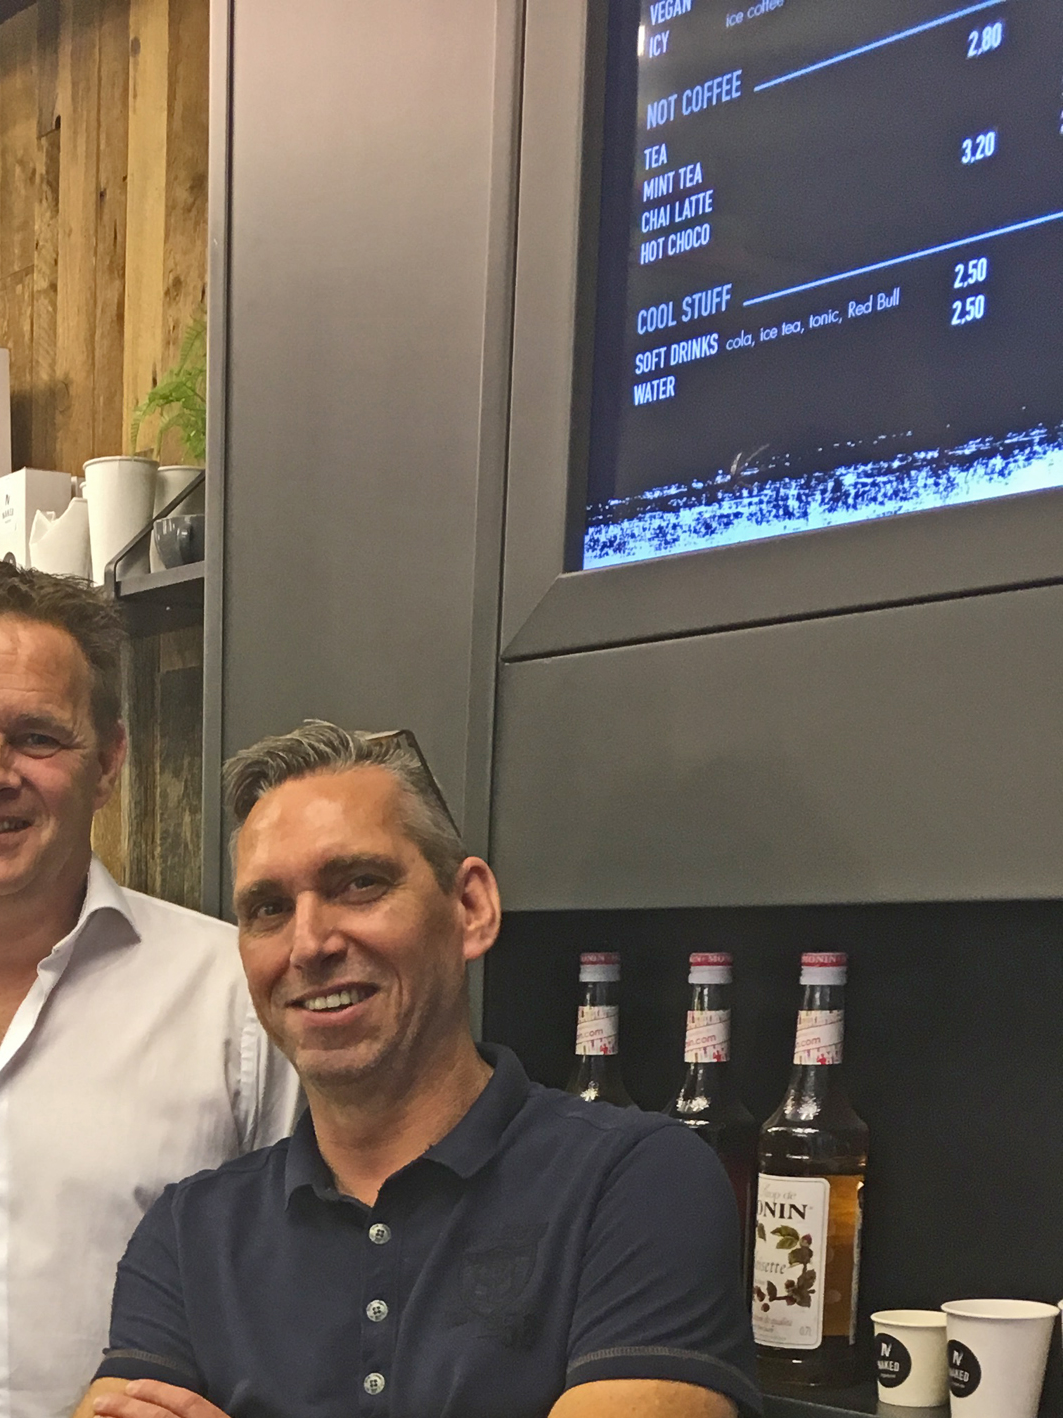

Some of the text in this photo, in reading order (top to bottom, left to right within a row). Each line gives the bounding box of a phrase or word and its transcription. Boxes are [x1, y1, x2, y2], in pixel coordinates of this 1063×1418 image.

[650, 0, 692, 26] VEGAN
[726, 12, 744, 28] ice
[649, 30, 670, 58] ICY
[966, 22, 1003, 59] 2,80
[646, 69, 743, 130] NOT COFFEE
[644, 143, 668, 171] TEA
[961, 131, 996, 164] 3,20
[643, 162, 703, 203] MINT TEA
[641, 189, 714, 233] CHAI LATTE
[640, 223, 710, 265] HOT CHOCO
[953, 257, 988, 289] 2,50
[637, 283, 733, 335] COOL STUFF
[950, 294, 985, 326] 2,50
[635, 287, 901, 375] SOFT DRINKS cola, ice tea, tonic, Red Bull
[633, 375, 676, 406] WATER
[758, 1200, 808, 1220] ONIN
[877, 1360, 900, 1372] NAKED
